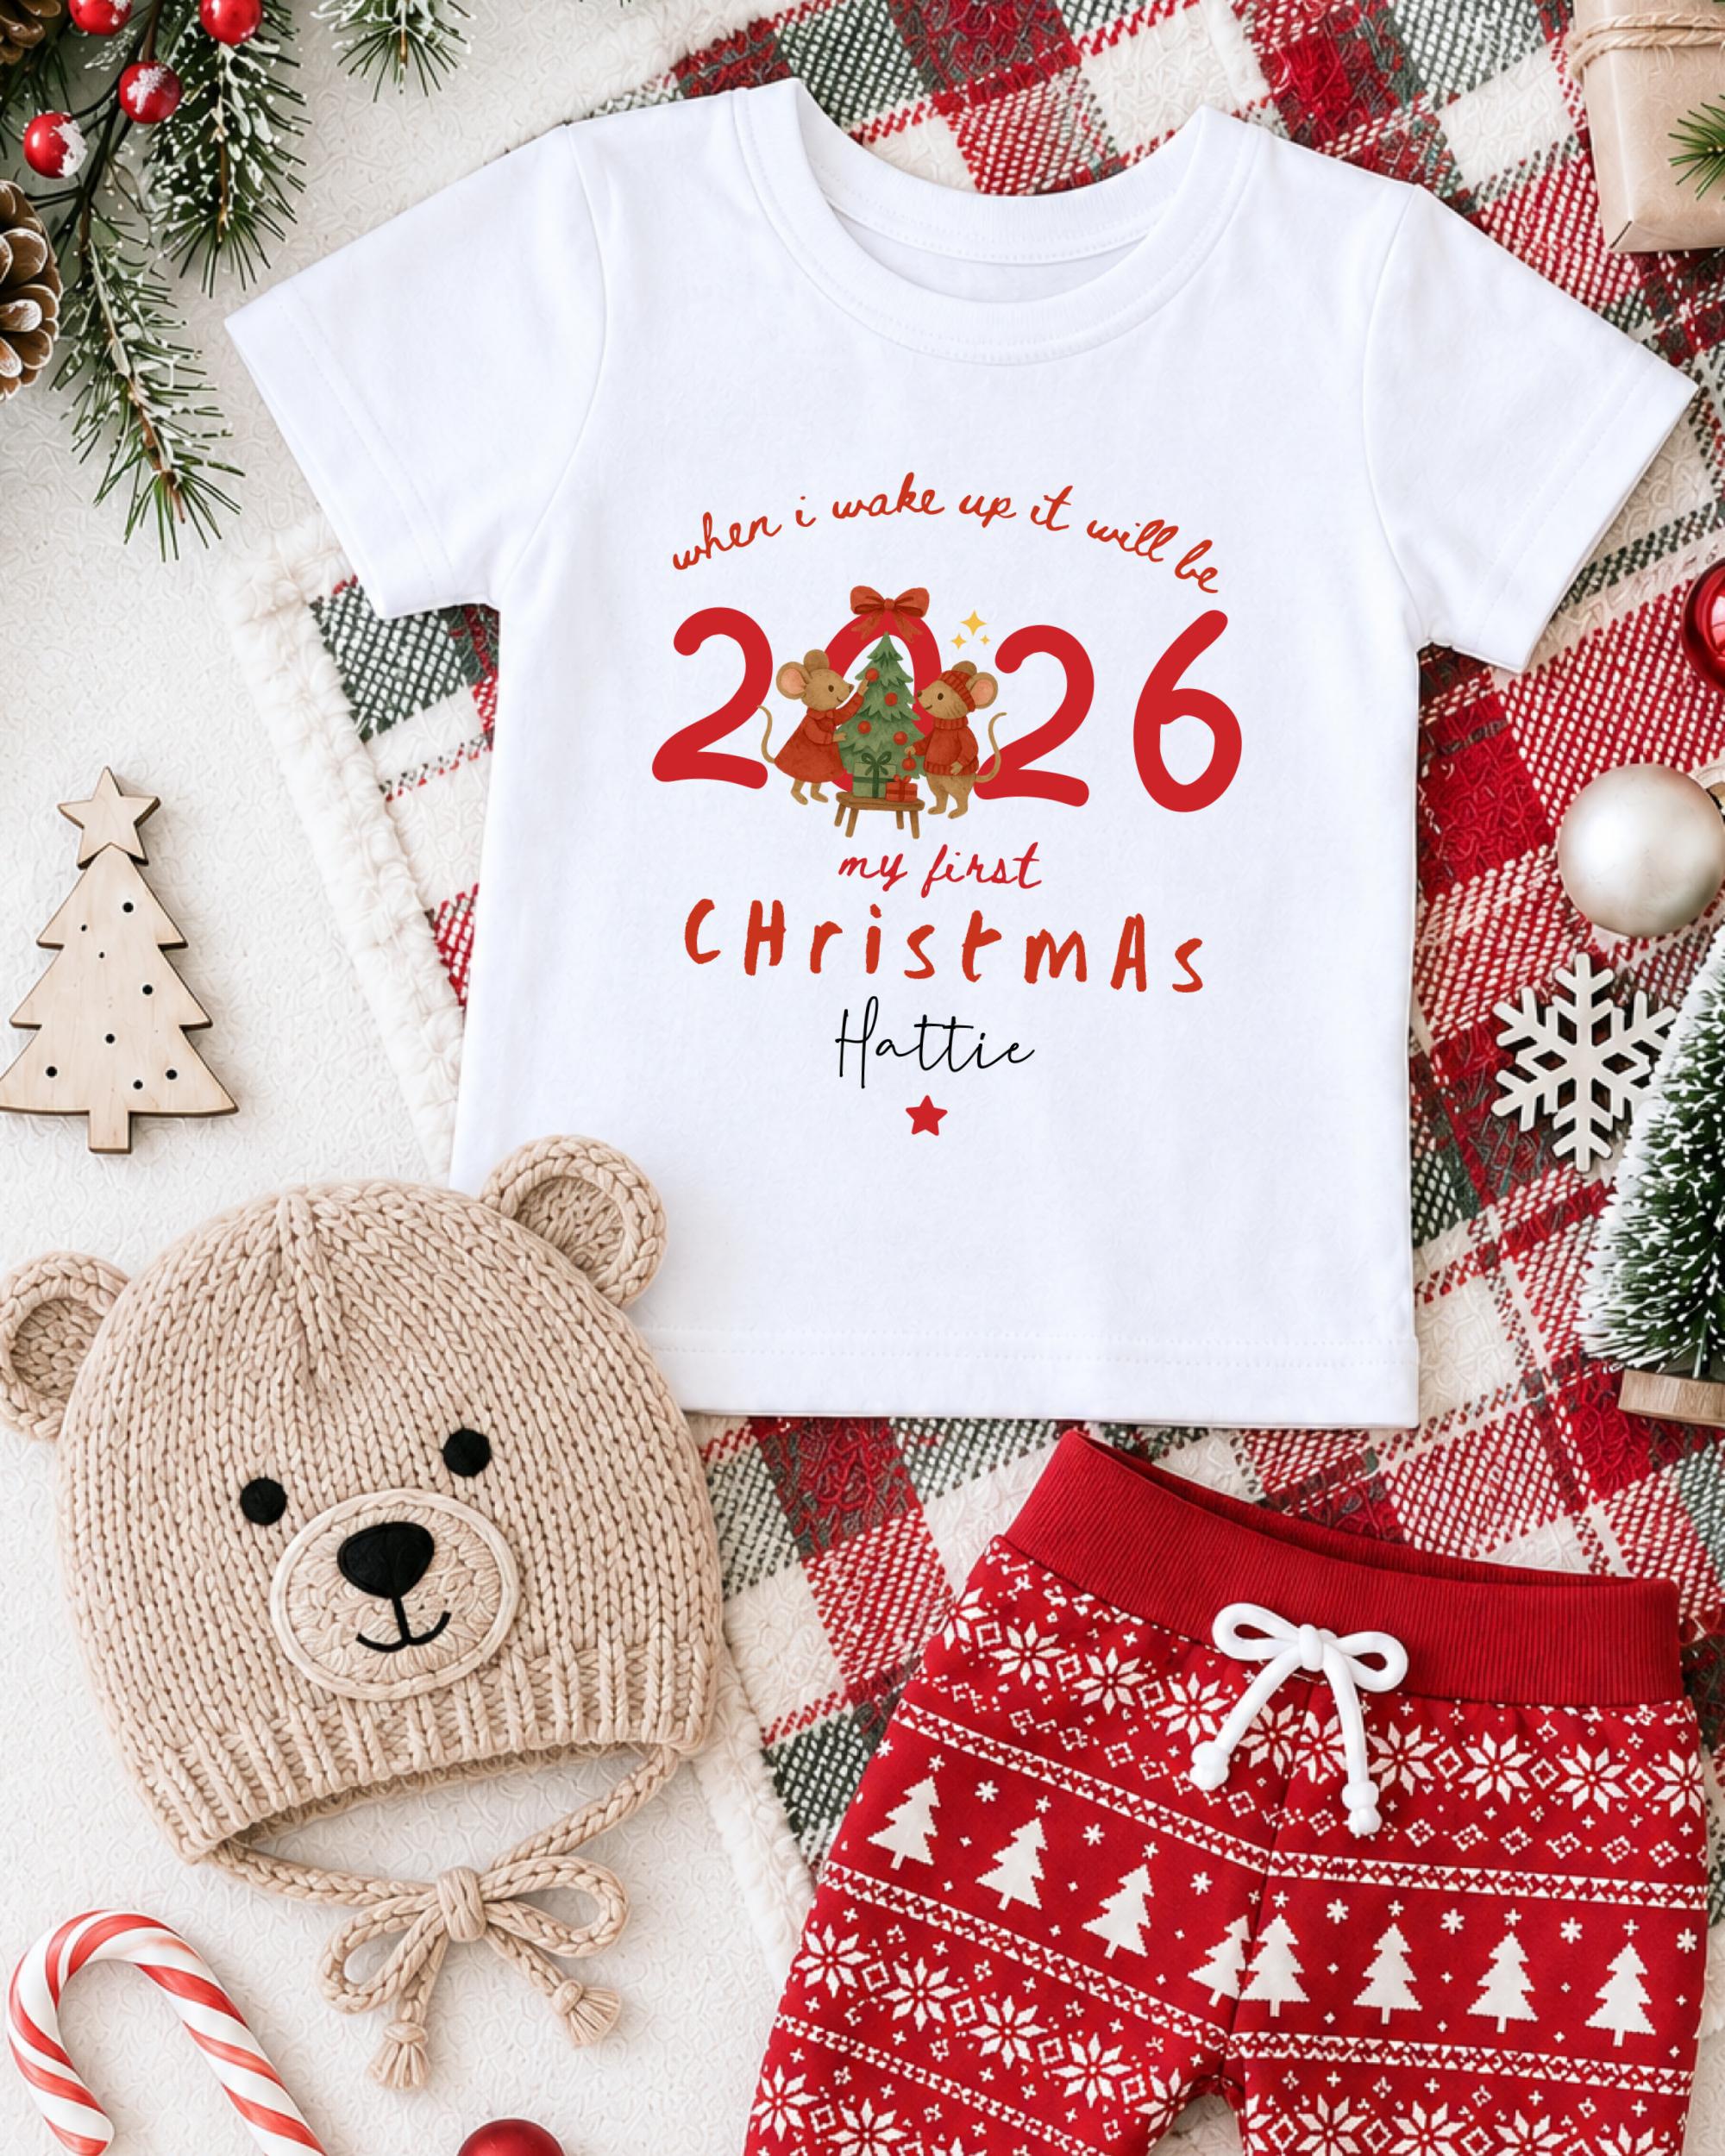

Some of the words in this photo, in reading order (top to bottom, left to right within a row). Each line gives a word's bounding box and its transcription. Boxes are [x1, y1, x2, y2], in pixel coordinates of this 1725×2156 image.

[672, 511, 783, 571] when
[794, 496, 817, 528] i
[831, 471, 946, 520] wake
[958, 494, 1017, 529] up
[1030, 485, 1074, 532] it
[1086, 518, 1180, 563] will
[1174, 538, 1219, 594] be
[837, 852, 908, 893] my
[920, 841, 1043, 899] first
[834, 995, 1036, 1089] Hattie
